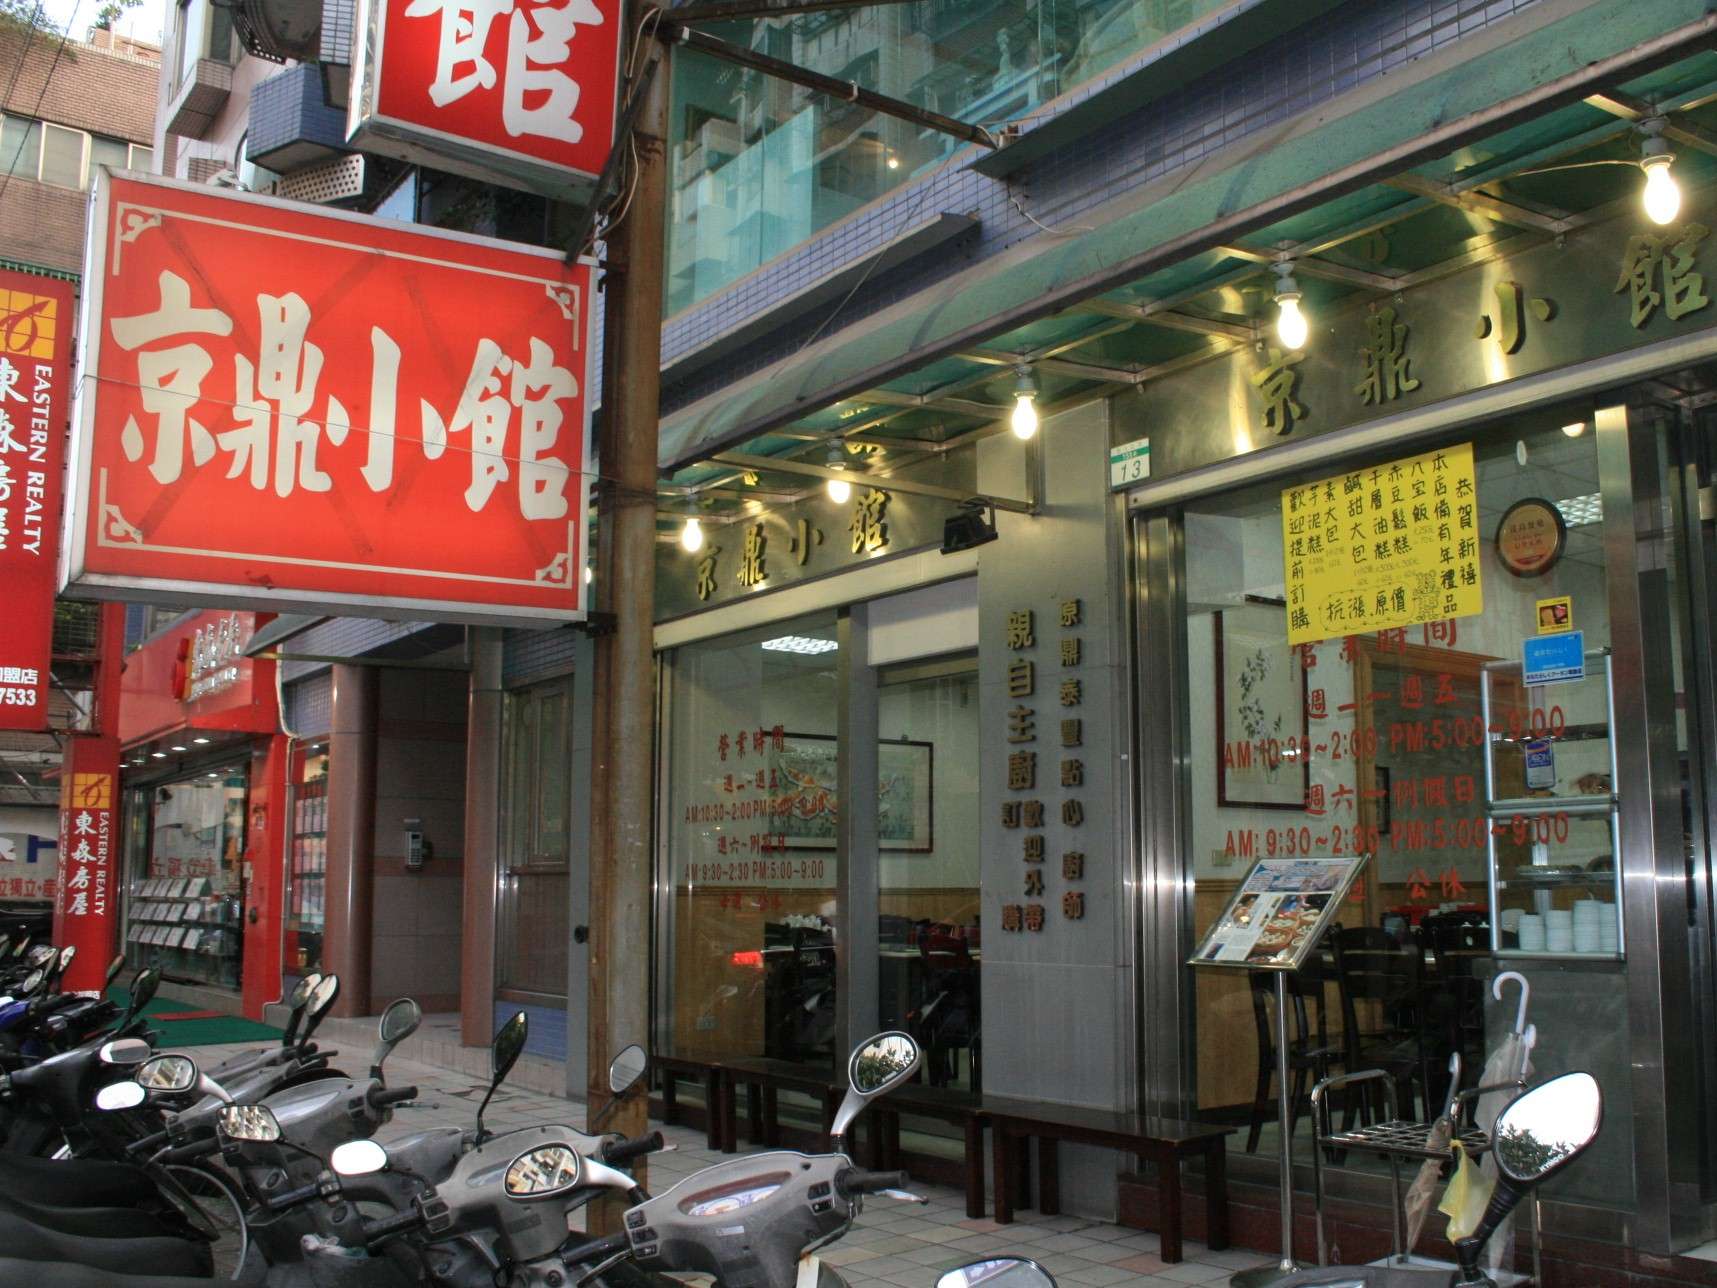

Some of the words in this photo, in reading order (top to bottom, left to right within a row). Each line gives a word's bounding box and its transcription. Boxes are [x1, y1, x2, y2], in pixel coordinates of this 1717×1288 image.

[405, 0, 604, 143] 館
[1251, 222, 1711, 435] 京鼎小館
[28, 363, 53, 463] EASTERN
[110, 269, 579, 520] 京鼎小館
[23, 470, 46, 557] REALTY
[1121, 460, 1141, 481] 13
[698, 487, 889, 601] 京鼎小館
[1288, 490, 1310, 632] 歡迎提前訂購
[1432, 453, 1458, 614] 本店備有年禮品
[1455, 477, 1478, 587] 恭賀新禧
[0, 666, 39, 686] 盟店
[67, 810, 98, 916] 東森房屋
[97, 811, 110, 866] EASTERN
[94, 870, 107, 916] REALTY
